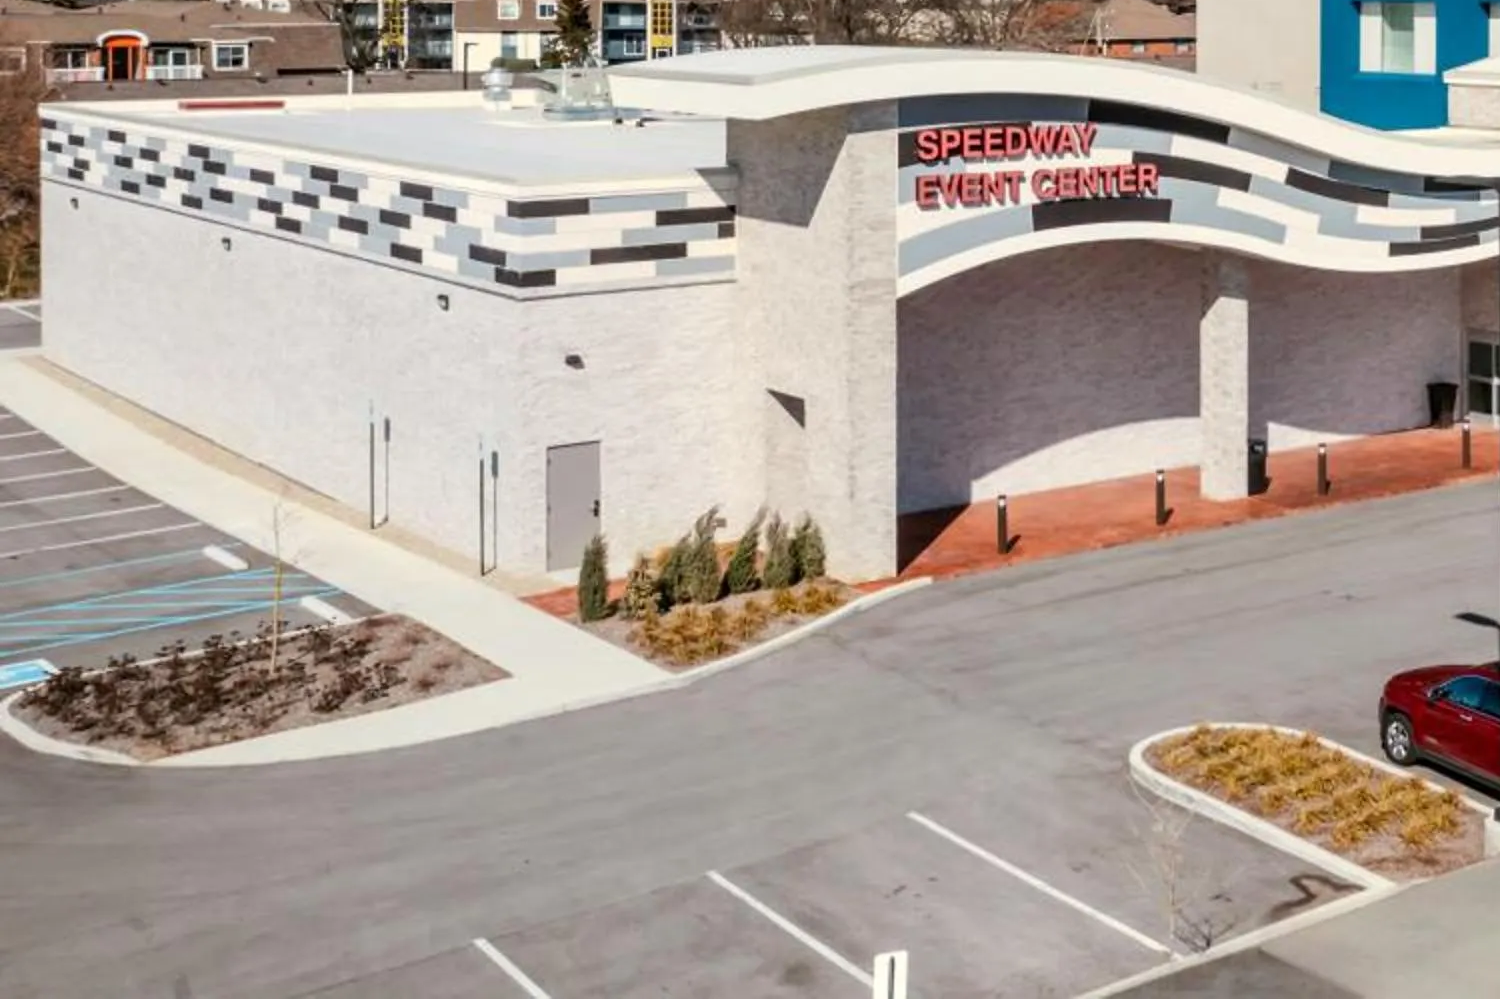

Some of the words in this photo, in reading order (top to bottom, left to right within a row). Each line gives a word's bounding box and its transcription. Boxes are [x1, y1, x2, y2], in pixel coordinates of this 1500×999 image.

[917, 123, 1097, 161] SPEEDWAY
[916, 171, 1025, 210] EVENT
[1032, 163, 1158, 203] CENTER
